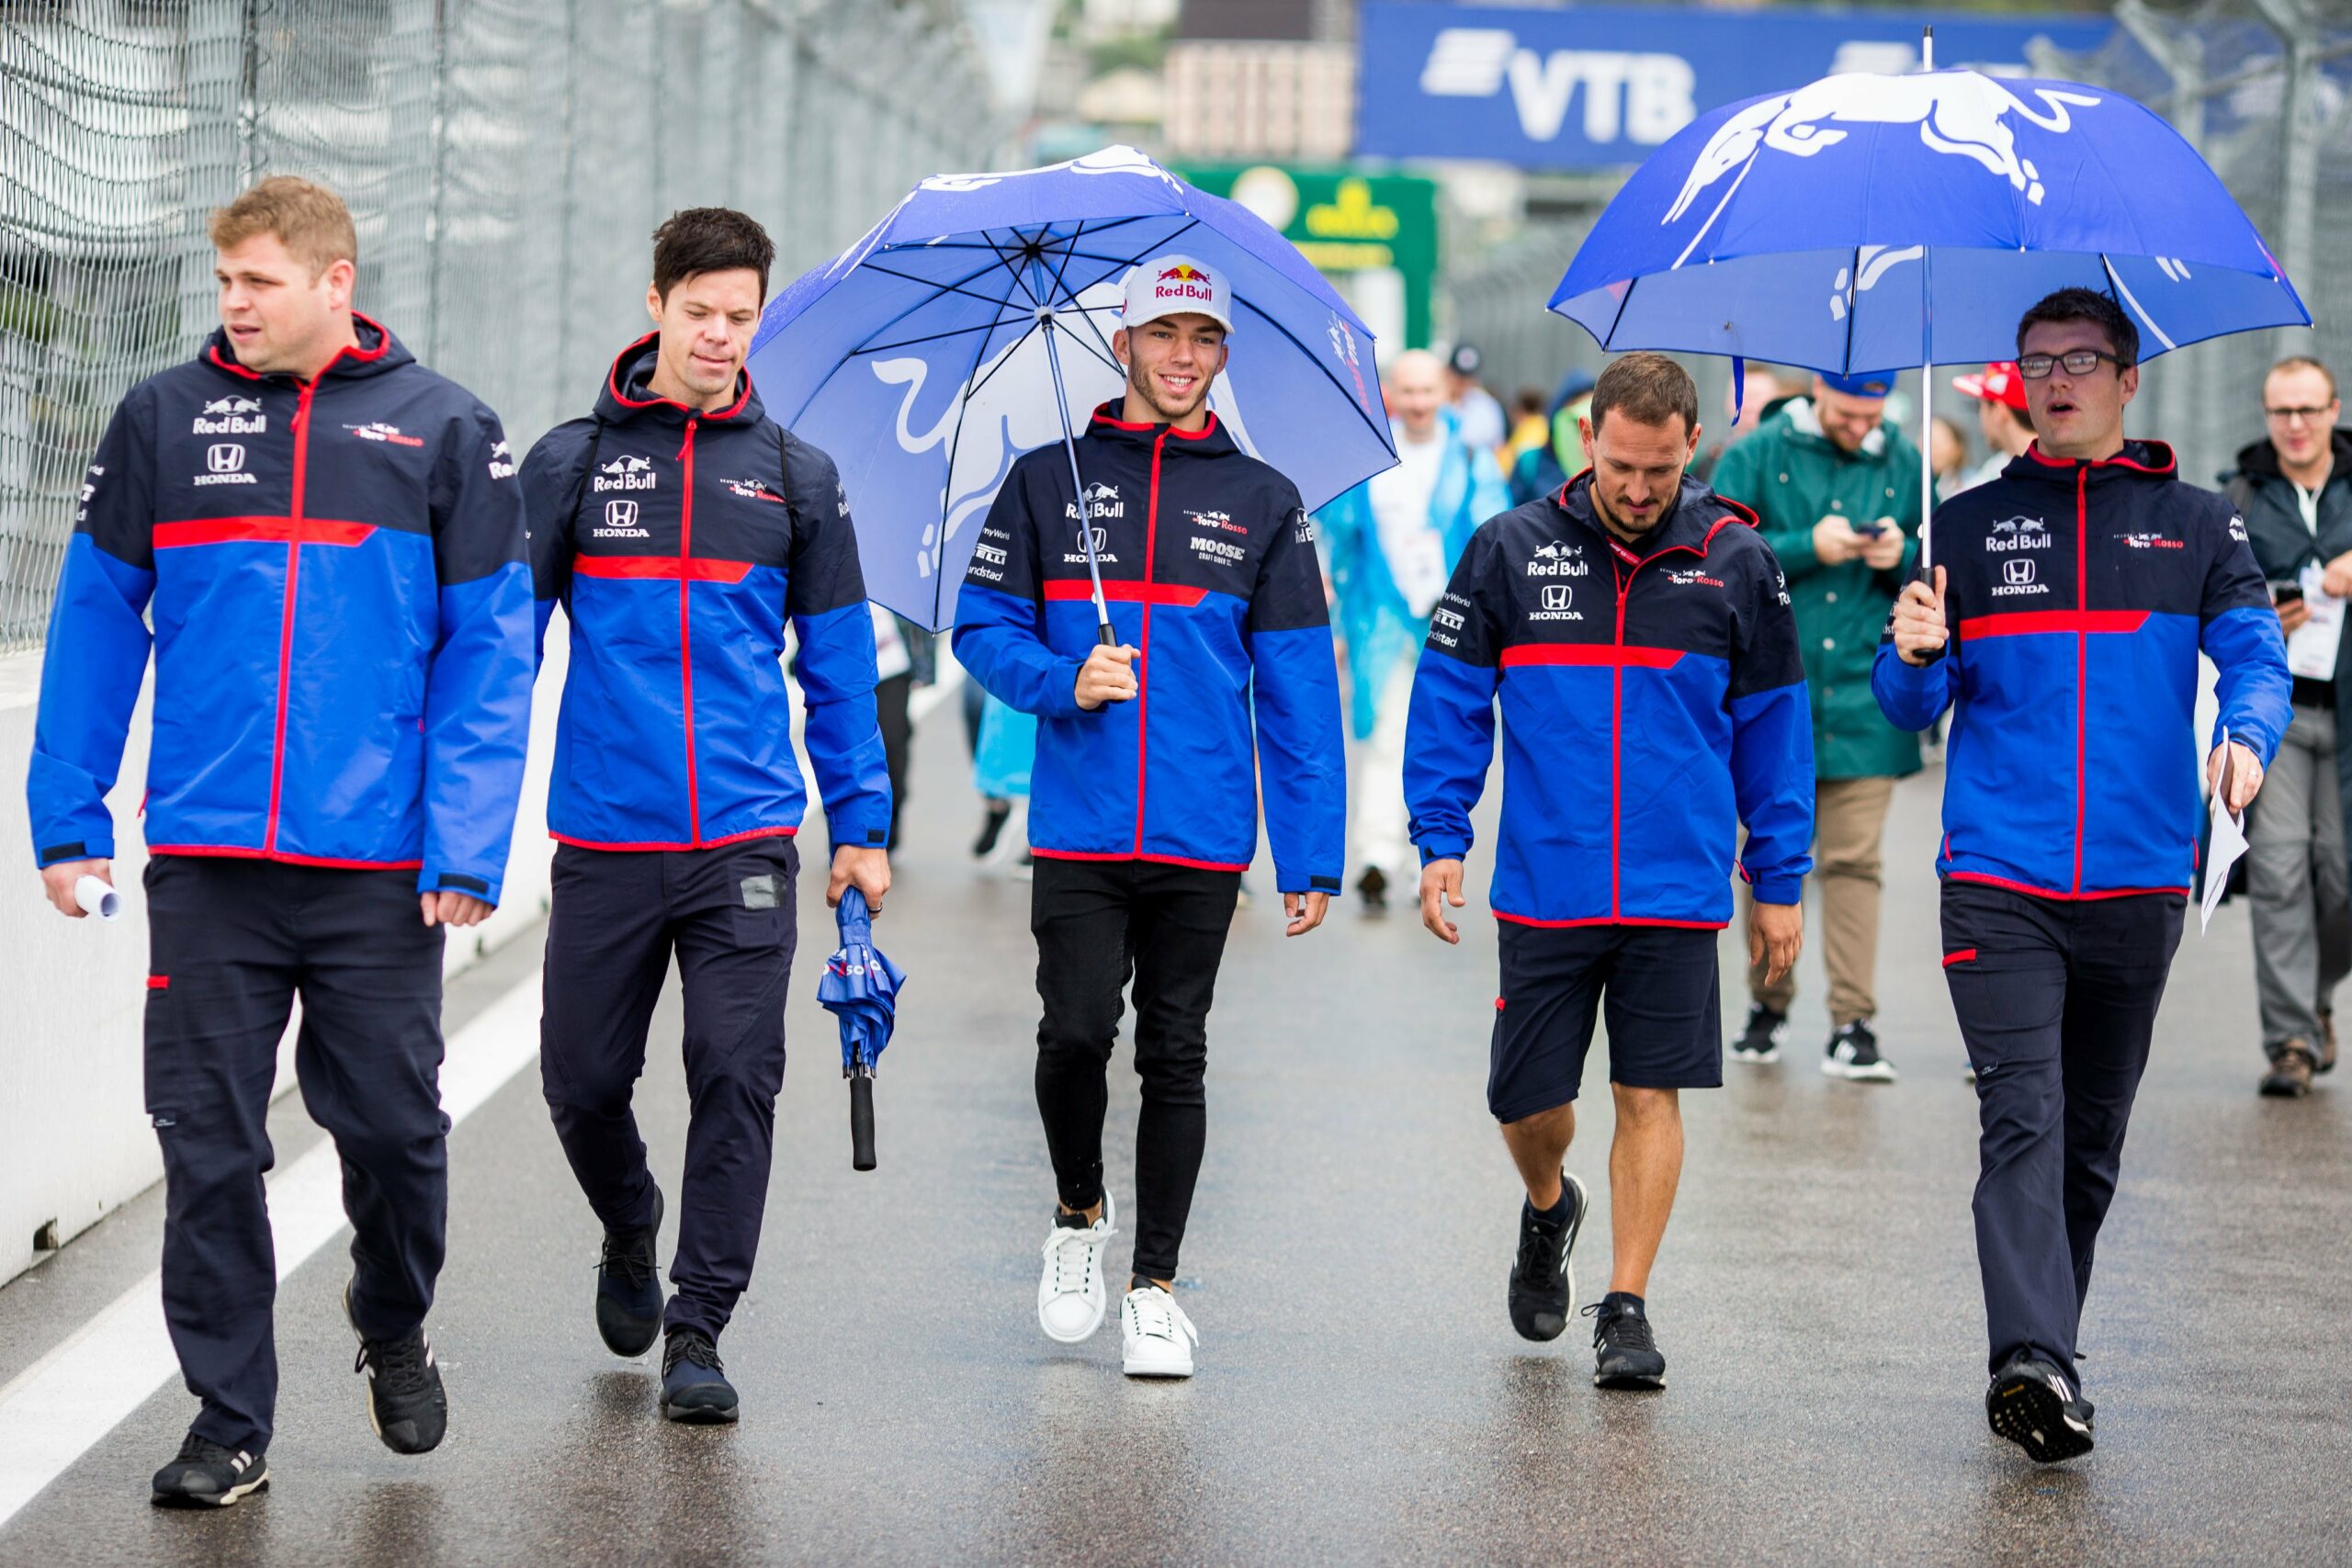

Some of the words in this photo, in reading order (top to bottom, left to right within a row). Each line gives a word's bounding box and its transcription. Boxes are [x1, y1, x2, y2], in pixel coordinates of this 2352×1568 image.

[1507, 48, 1697, 144] VTB
[1155, 283, 1184, 299] Red
[1185, 285, 1212, 302] Bull
[192, 416, 231, 434] Red
[231, 414, 266, 434] Bull
[489, 461, 513, 479] Re
[193, 473, 258, 486] HONDA
[594, 473, 625, 492] Red
[625, 472, 657, 490] Bull
[1093, 502, 1125, 518] Bull
[593, 528, 650, 537] HONDA
[1196, 515, 1218, 528] Toro
[1220, 520, 1249, 535] Rosso
[1190, 536, 1246, 561] MOOSE
[1985, 534, 2018, 552] Red
[2019, 533, 2052, 549] Bull
[1064, 553, 1118, 563] HODA
[967, 565, 1004, 582] ndstad
[1527, 561, 1558, 577] Red
[1559, 562, 1589, 577] Bull
[1672, 574, 1694, 585] Toro
[1696, 575, 1725, 588] Rosso
[1991, 583, 2051, 597] HONDA
[1529, 611, 1584, 621] HONDA
[1427, 630, 1459, 649] ndstad
